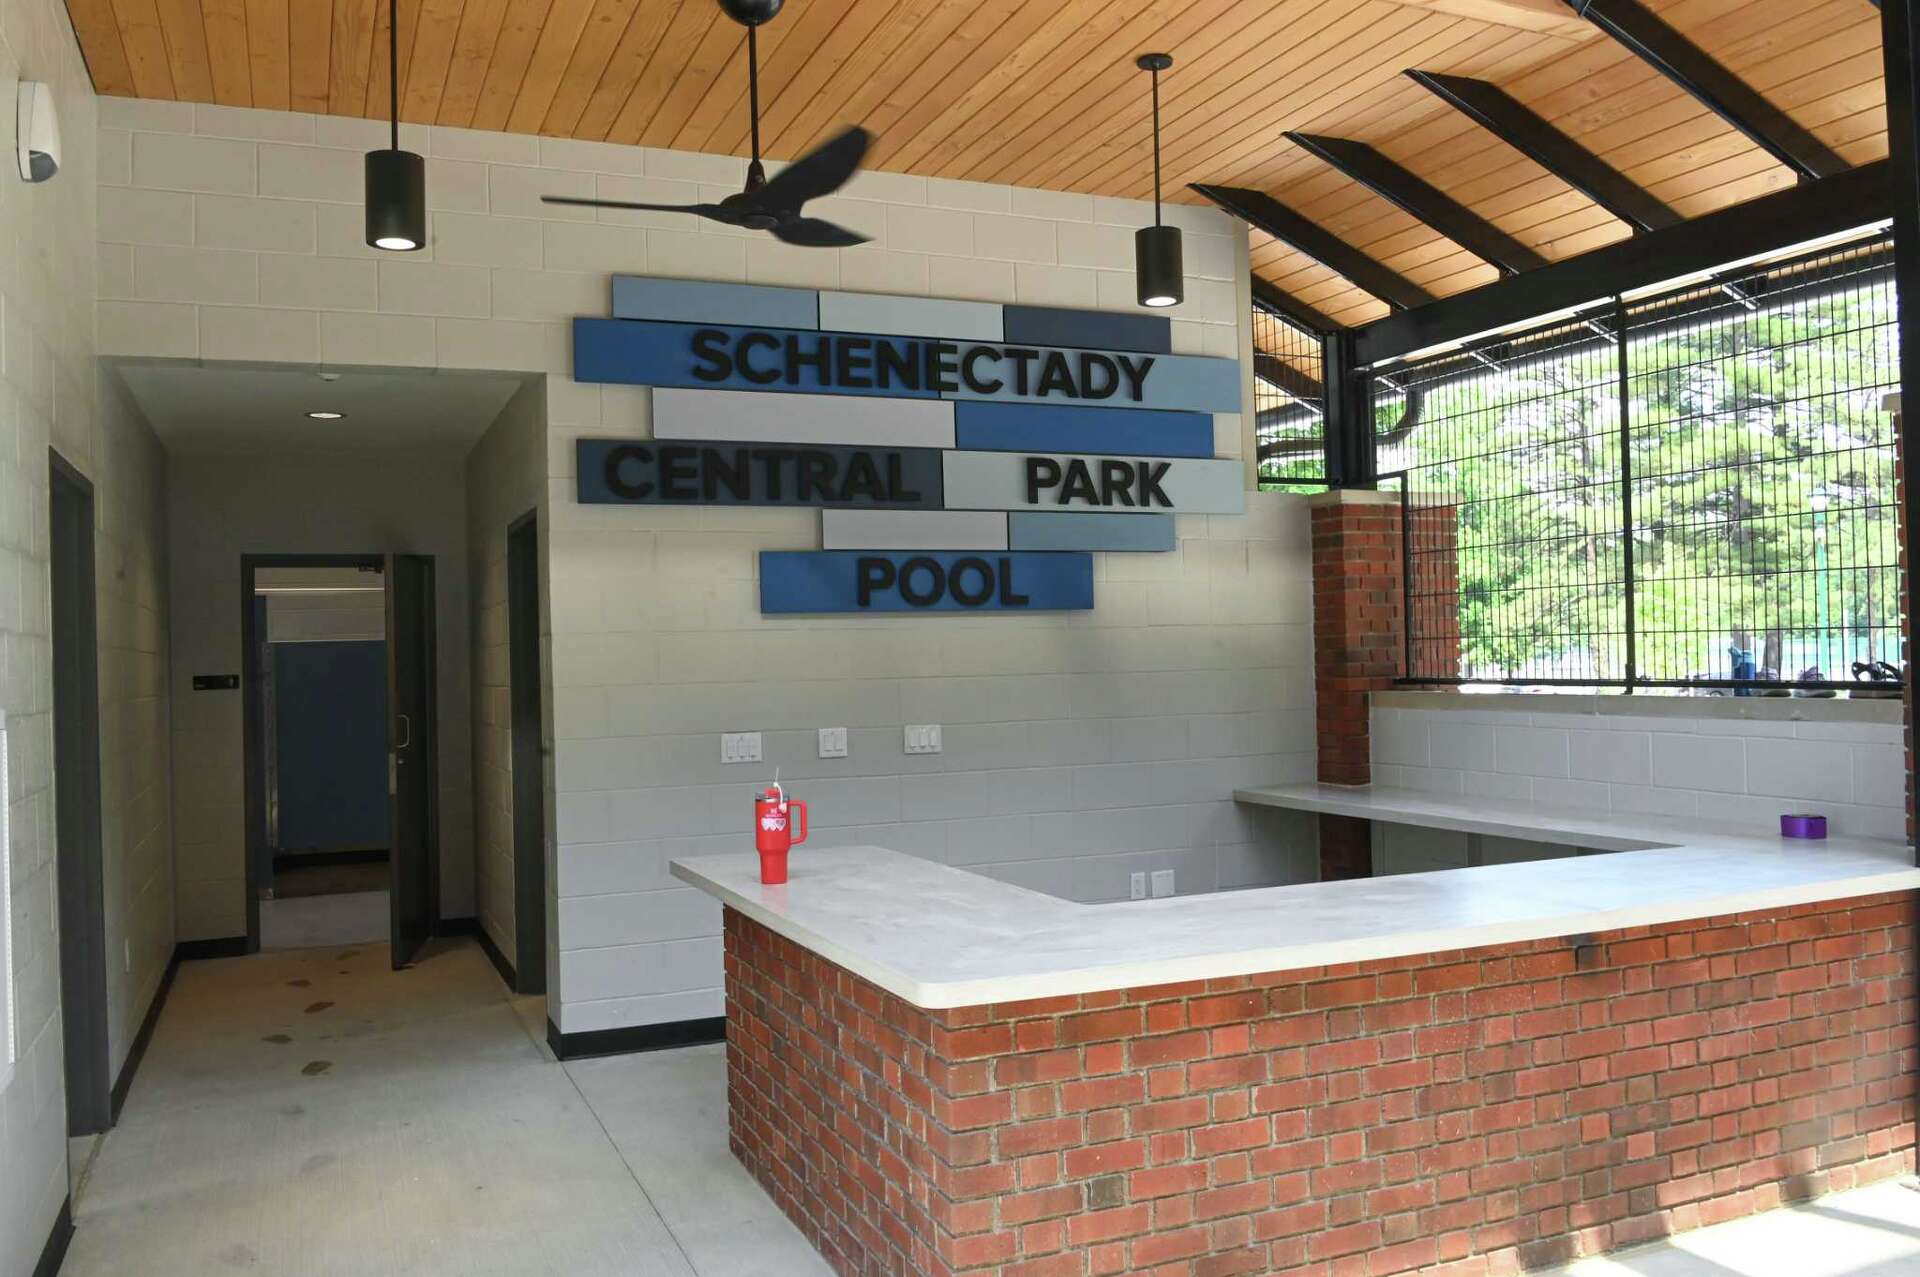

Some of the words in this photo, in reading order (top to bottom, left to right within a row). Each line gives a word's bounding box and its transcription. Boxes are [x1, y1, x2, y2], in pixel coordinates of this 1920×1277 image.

[691, 329, 1156, 402] SCHENECTADY
[604, 445, 922, 502] CENTRAL
[1026, 457, 1174, 508] PARK
[857, 557, 1030, 608] POOL
